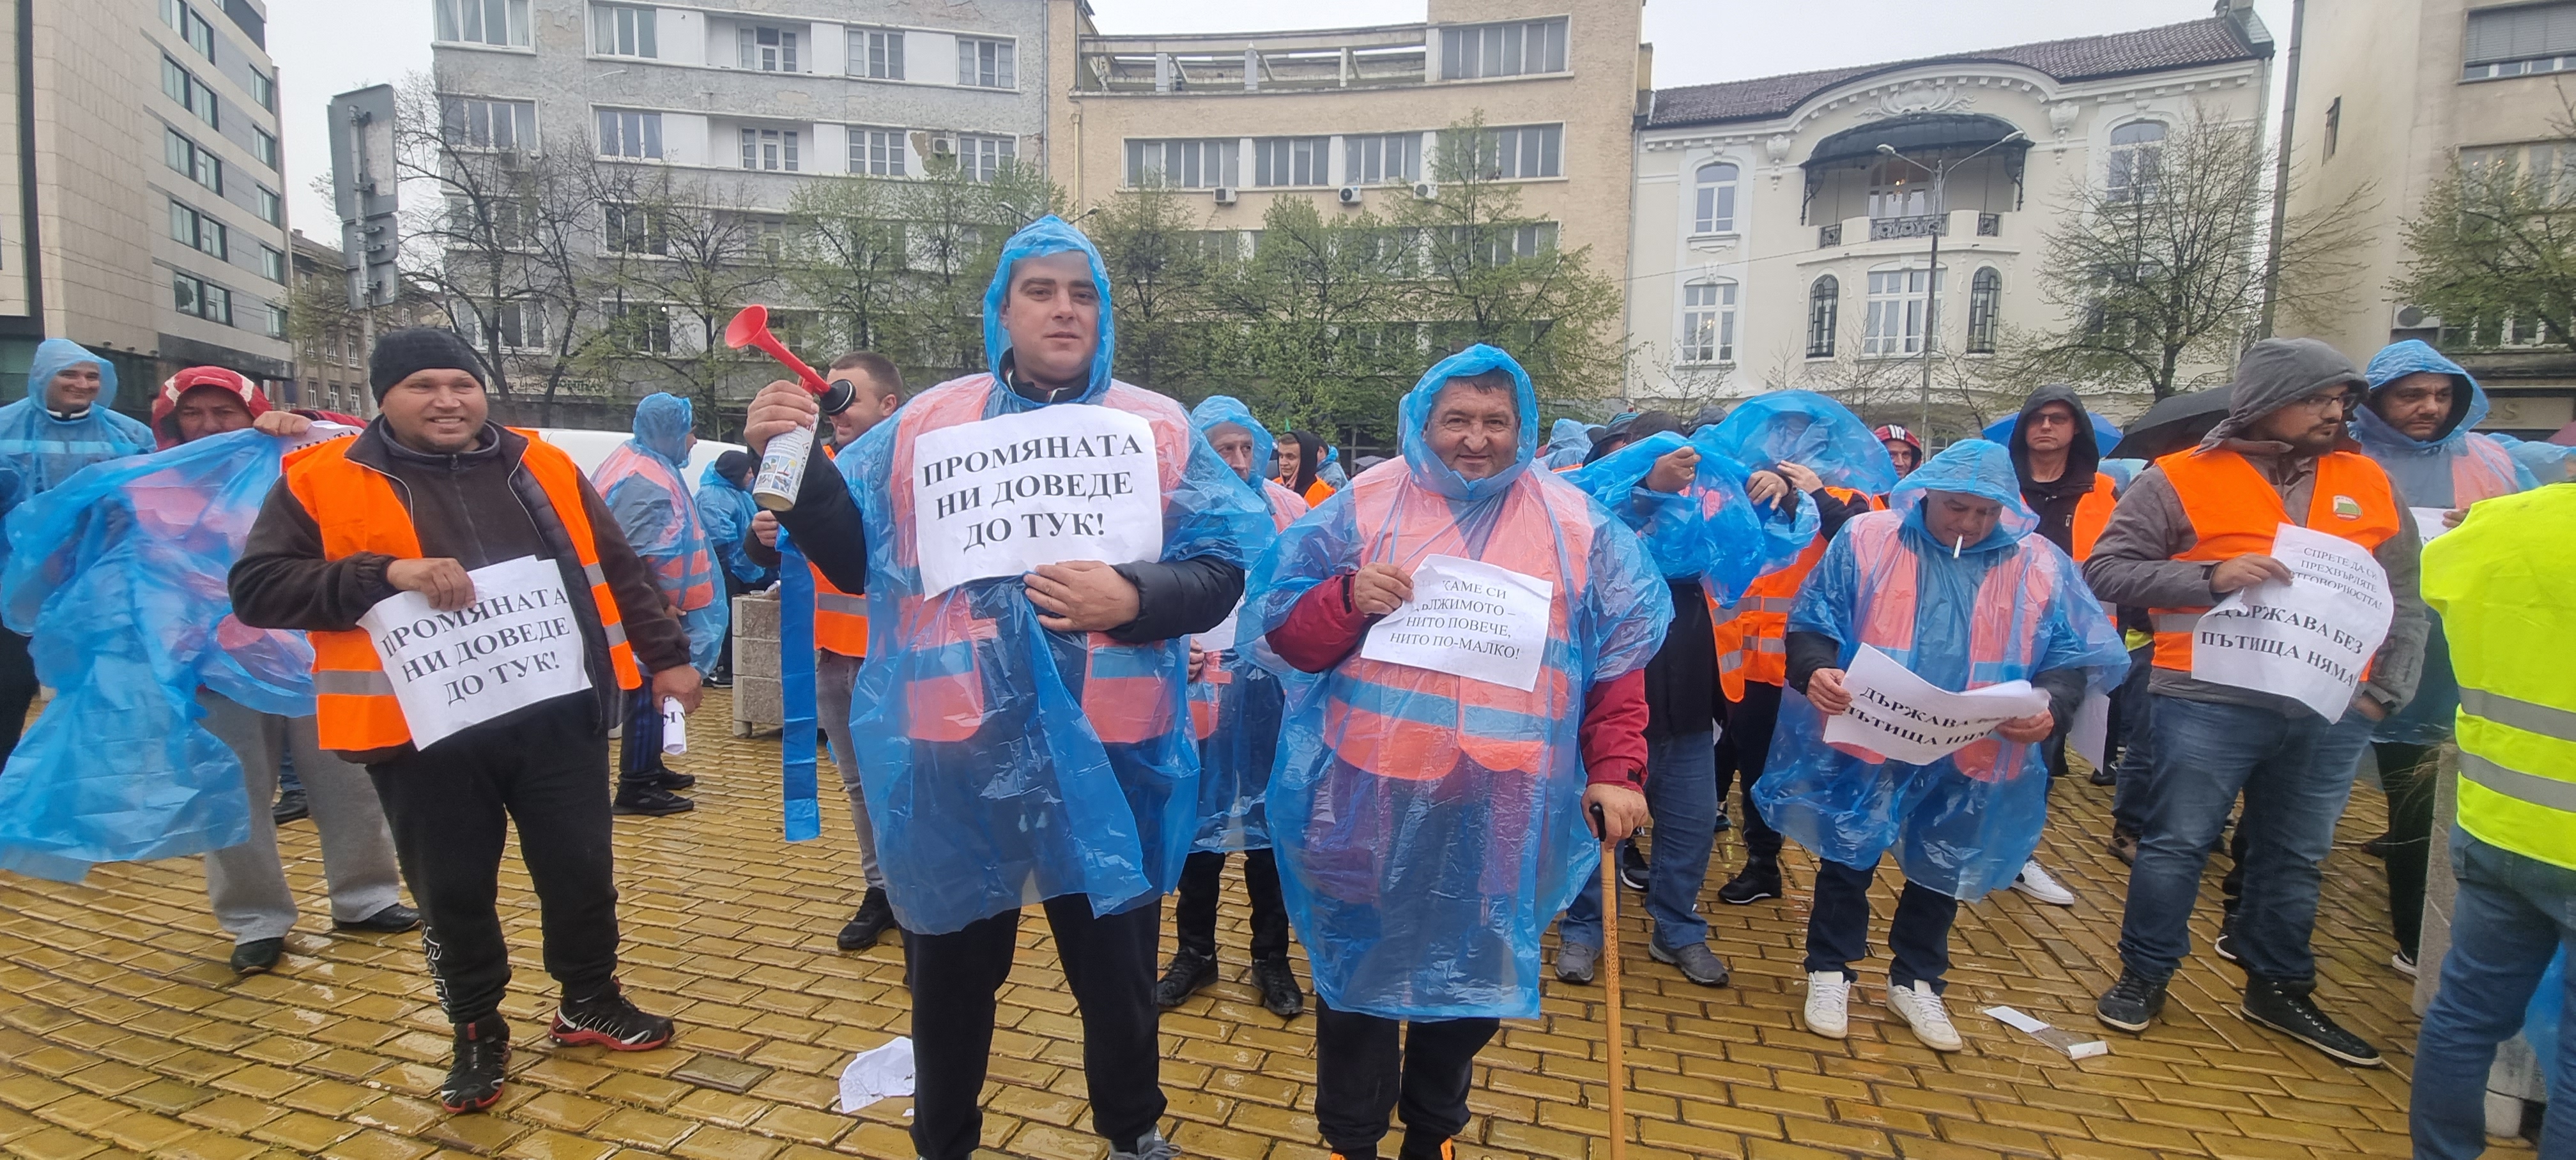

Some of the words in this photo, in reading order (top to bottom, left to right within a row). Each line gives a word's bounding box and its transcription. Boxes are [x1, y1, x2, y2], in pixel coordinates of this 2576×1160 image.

[923, 434, 1143, 487] ПРОМЯНАТА
[937, 487, 981, 520] НИ
[991, 471, 1133, 508] ДОВЕДЕ
[963, 518, 1012, 554] ДО
[1021, 512, 1105, 538] ТУК!
[2301, 560, 2377, 593] ПРЕХВЪРЛЯТЕ
[2304, 547, 2349, 567] СПРЕТЕ
[2350, 562, 2365, 574] ДА
[1414, 599, 1505, 616] ЪЛЖИМОТО
[1486, 587, 1506, 599] СИ
[2294, 572, 2382, 609] ТГОВОРНОСТТА!
[381, 588, 567, 658] ПРОМЯНАТА
[1406, 616, 1445, 629] НИТО
[1448, 617, 1512, 639] ПОВЕЧЕ,
[401, 650, 450, 683] НИ
[454, 617, 571, 665] ДОВЕДЕ
[1390, 632, 1430, 646] НИТО
[1433, 636, 1520, 660] ПО-МАЛКО!
[2201, 631, 2300, 659] ПЪТИЩА
[2333, 629, 2363, 654] БЕЗ
[444, 675, 484, 706] ДО
[489, 651, 560, 685] ТУК!
[1859, 687, 1968, 728] ДЪРЖАВА
